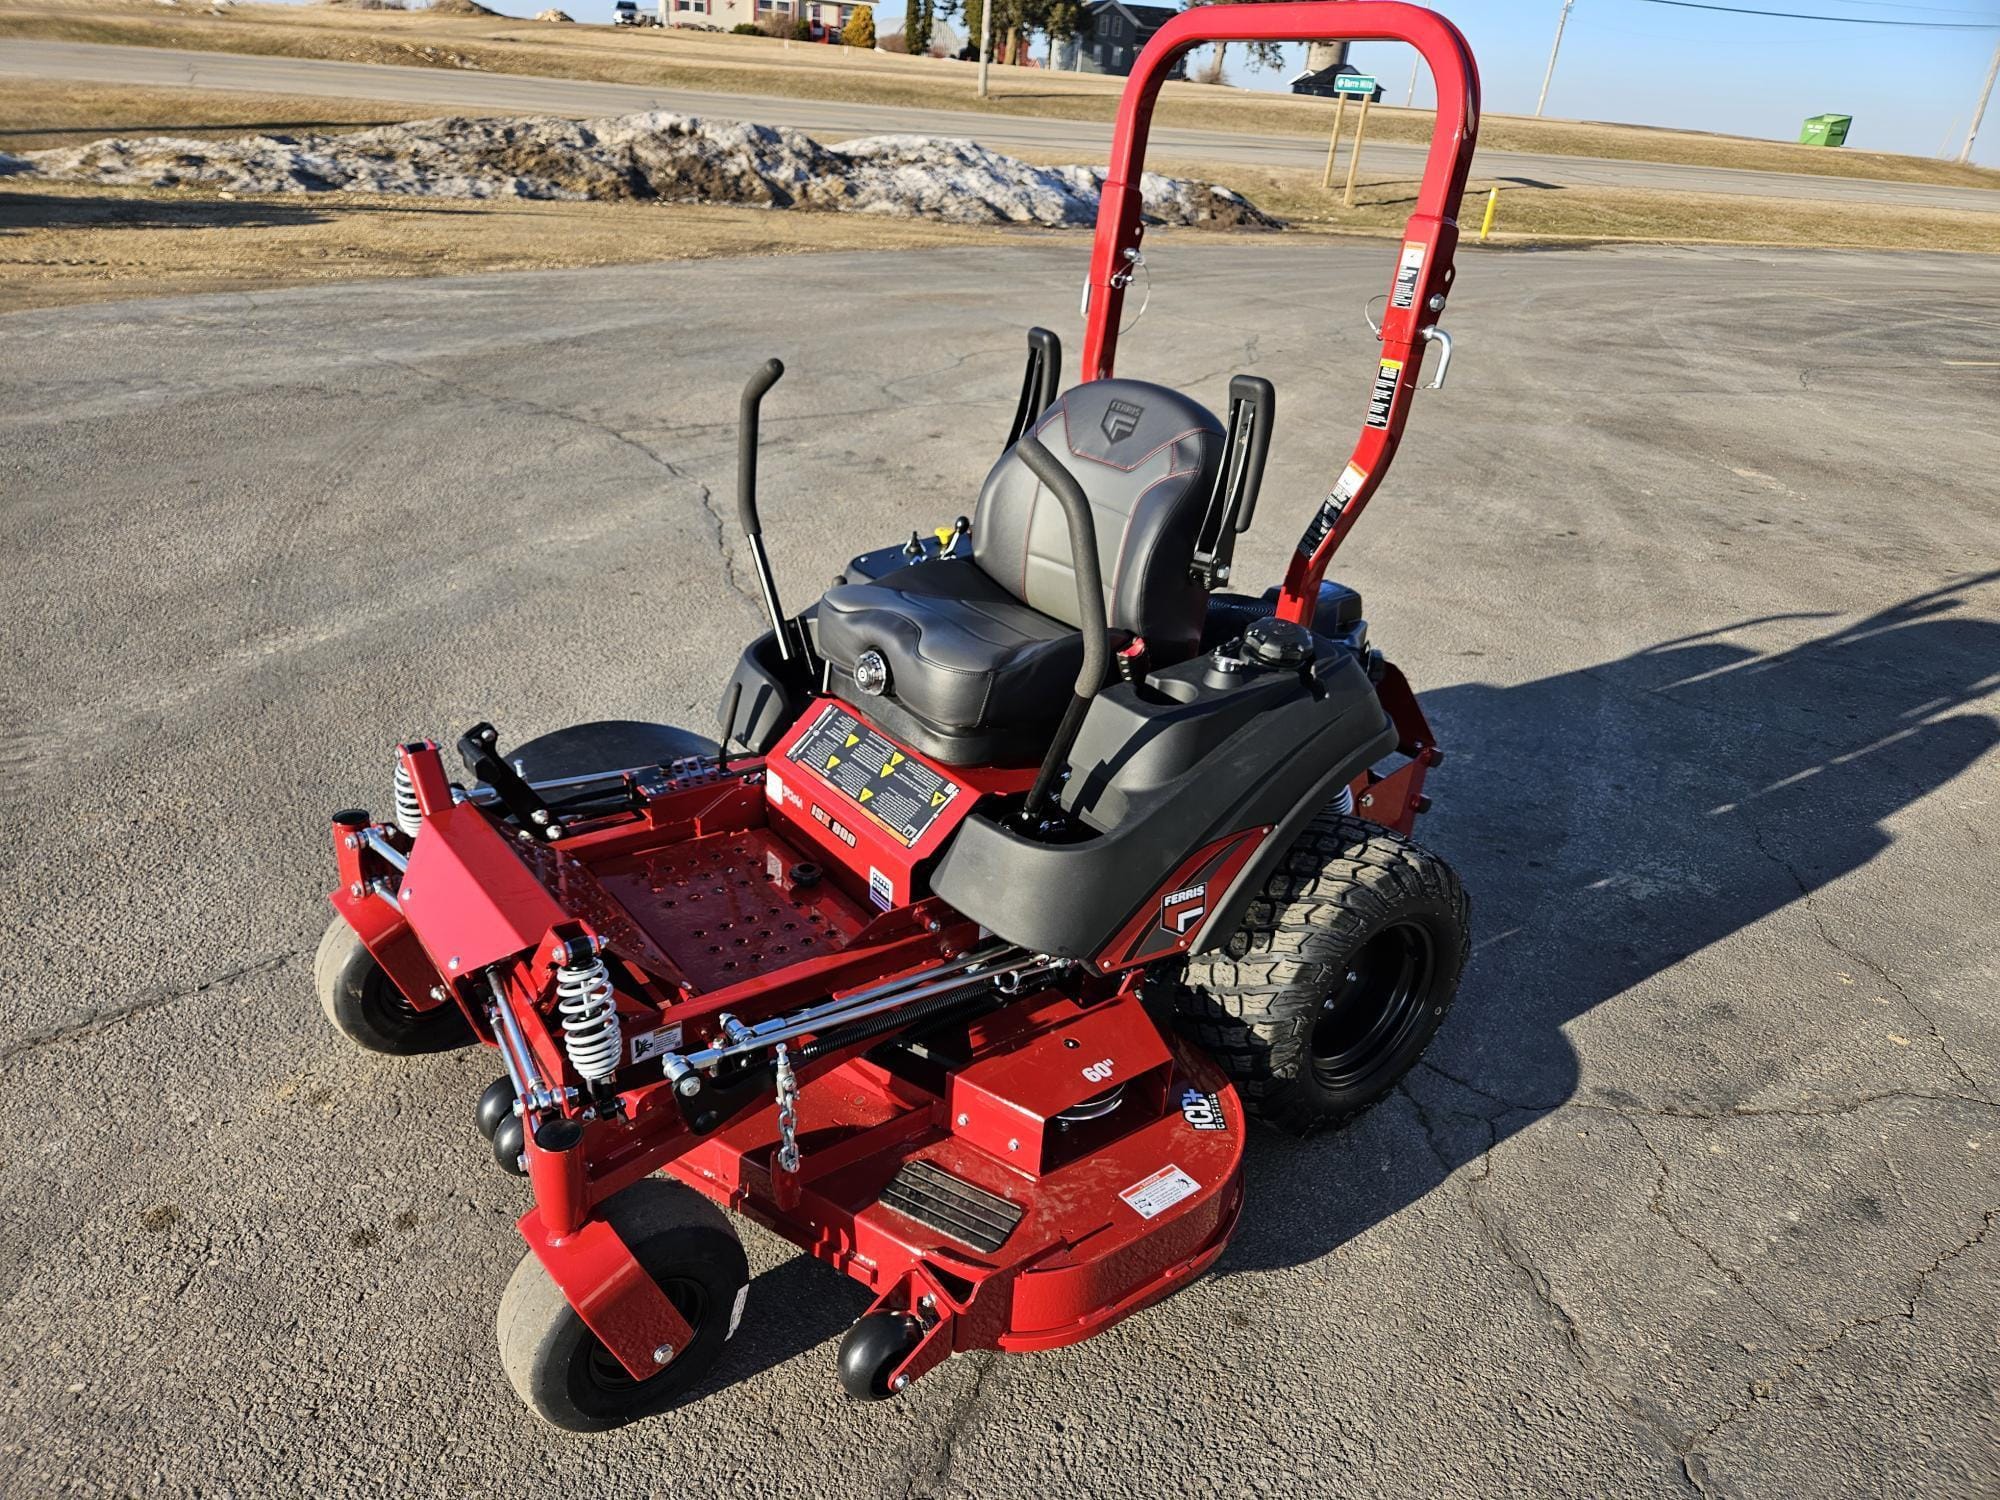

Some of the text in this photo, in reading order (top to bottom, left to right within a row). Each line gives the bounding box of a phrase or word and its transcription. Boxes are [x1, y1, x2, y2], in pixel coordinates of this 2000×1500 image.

[1110, 402, 1141, 416] FERRIS
[1164, 885, 1205, 907] FERRIS
[1082, 1058, 1115, 1083] 60"
[1208, 1093, 1227, 1130] CUTTING
